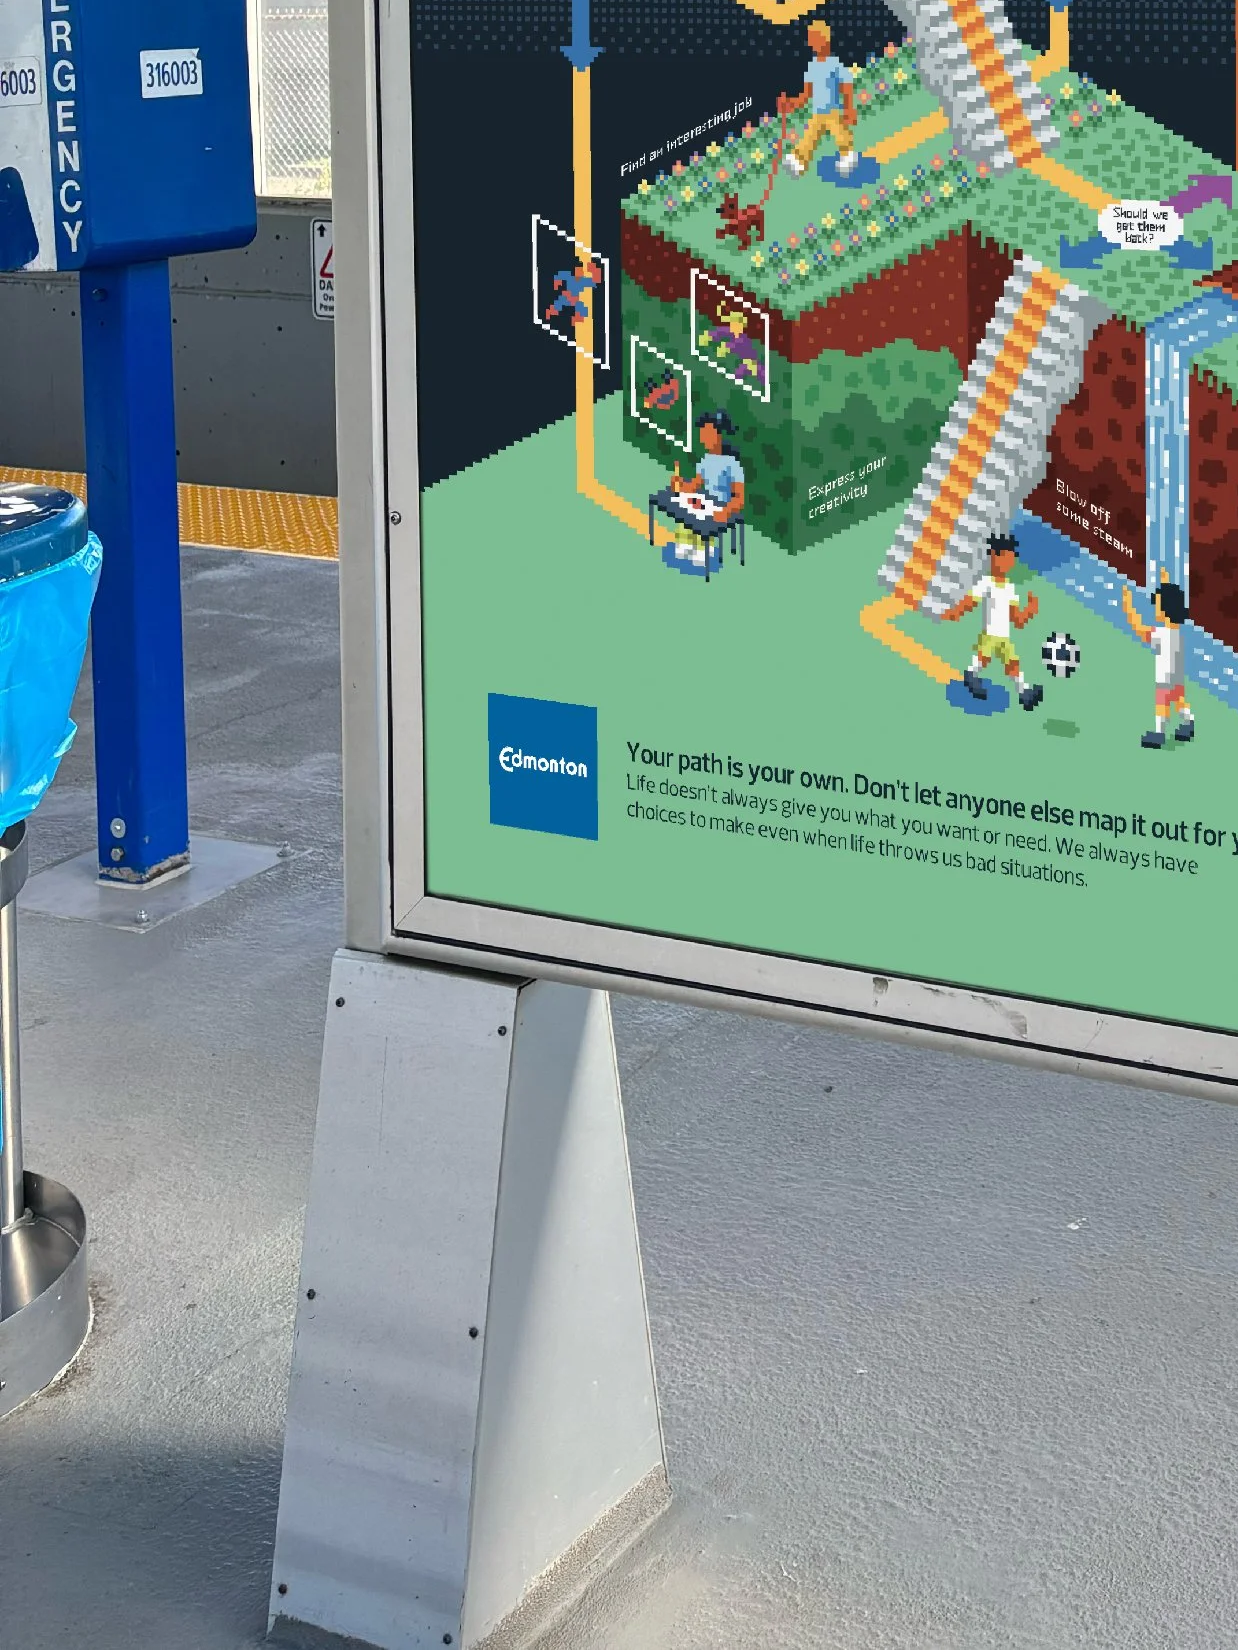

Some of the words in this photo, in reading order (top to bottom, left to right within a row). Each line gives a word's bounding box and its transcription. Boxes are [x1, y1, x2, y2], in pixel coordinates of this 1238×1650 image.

[146, 60, 199, 88] 316003
[620, 153, 646, 177] Find
[649, 150, 663, 162] an
[666, 109, 732, 153] interesting
[732, 96, 753, 120] job
[1113, 206, 1148, 220] Should
[1153, 211, 1168, 220] we
[1116, 221, 1134, 233] get
[1137, 221, 1166, 232] them
[1125, 232, 1154, 244] back?
[808, 471, 855, 501] Express
[858, 456, 887, 479] your
[808, 484, 868, 520] creativity
[1056, 478, 1087, 508] Blow
[1090, 503, 1111, 525] off
[1056, 501, 1089, 530] some
[1093, 526, 1133, 559] steam
[499, 745, 588, 778] Edmonton
[627, 741, 674, 768] Your
[679, 753, 723, 775] path
[727, 755, 743, 778] is
[749, 763, 795, 786] your
[800, 770, 849, 793] own.
[854, 773, 910, 801] Don't
[914, 781, 942, 807] let
[945, 788, 1026, 819] anyone
[1030, 799, 1075, 826] else
[1079, 808, 1127, 836] map
[1132, 813, 1147, 836] it
[1151, 820, 1189, 843] out
[1193, 822, 1227, 848] for
[627, 773, 656, 793] Life
[659, 777, 718, 802] doesn't
[721, 788, 778, 814] always
[781, 798, 816, 819] give
[820, 804, 851, 824] you
[854, 808, 897, 830] what
[901, 816, 932, 836] you
[937, 820, 980, 843] want
[983, 829, 1001, 847] or
[1005, 832, 1052, 853] need.
[1055, 836, 1085, 858] We
[1089, 842, 1151, 871] always
[1155, 851, 1199, 875] have
[627, 801, 687, 826] choices
[690, 810, 706, 828] to
[709, 815, 755, 836] make
[758, 824, 799, 843] even
[803, 829, 847, 850] when
[850, 833, 876, 855] life
[879, 838, 939, 865] throws
[942, 849, 962, 868] us
[965, 852, 996, 874] bad
[1000, 857, 1088, 888] situations.
